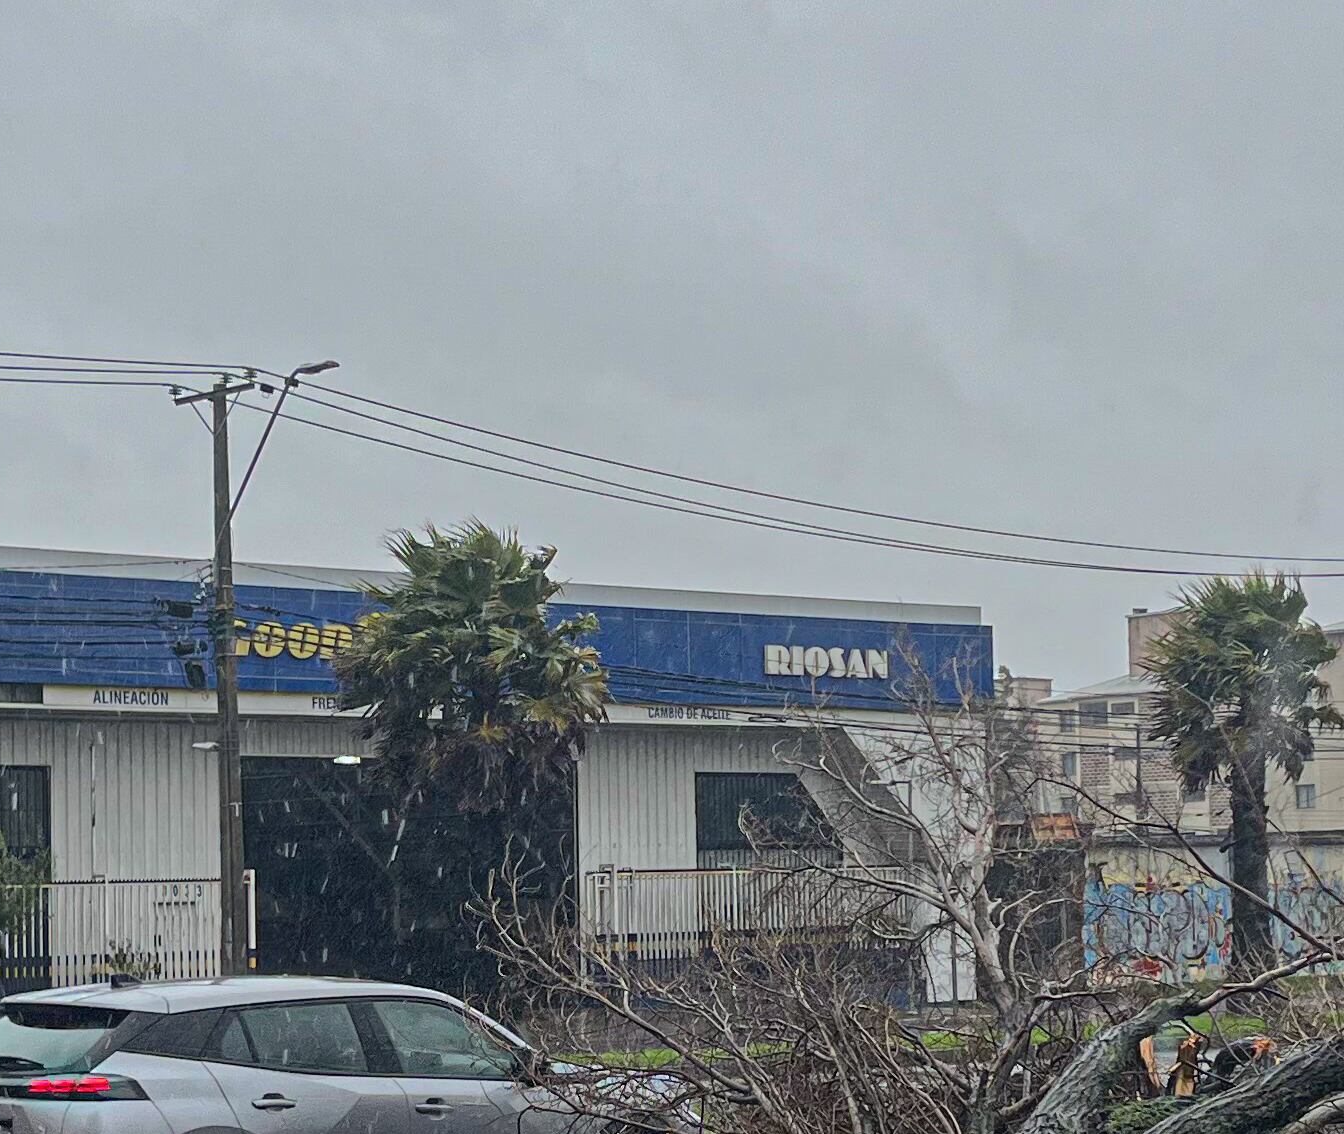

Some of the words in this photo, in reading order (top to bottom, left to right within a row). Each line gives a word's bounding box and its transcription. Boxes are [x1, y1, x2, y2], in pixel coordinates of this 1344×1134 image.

[763, 644, 889, 679] RIOSAN
[93, 688, 169, 706] ALINEACIÓN
[648, 706, 684, 719] CAMBIO
[686, 707, 699, 720] DE
